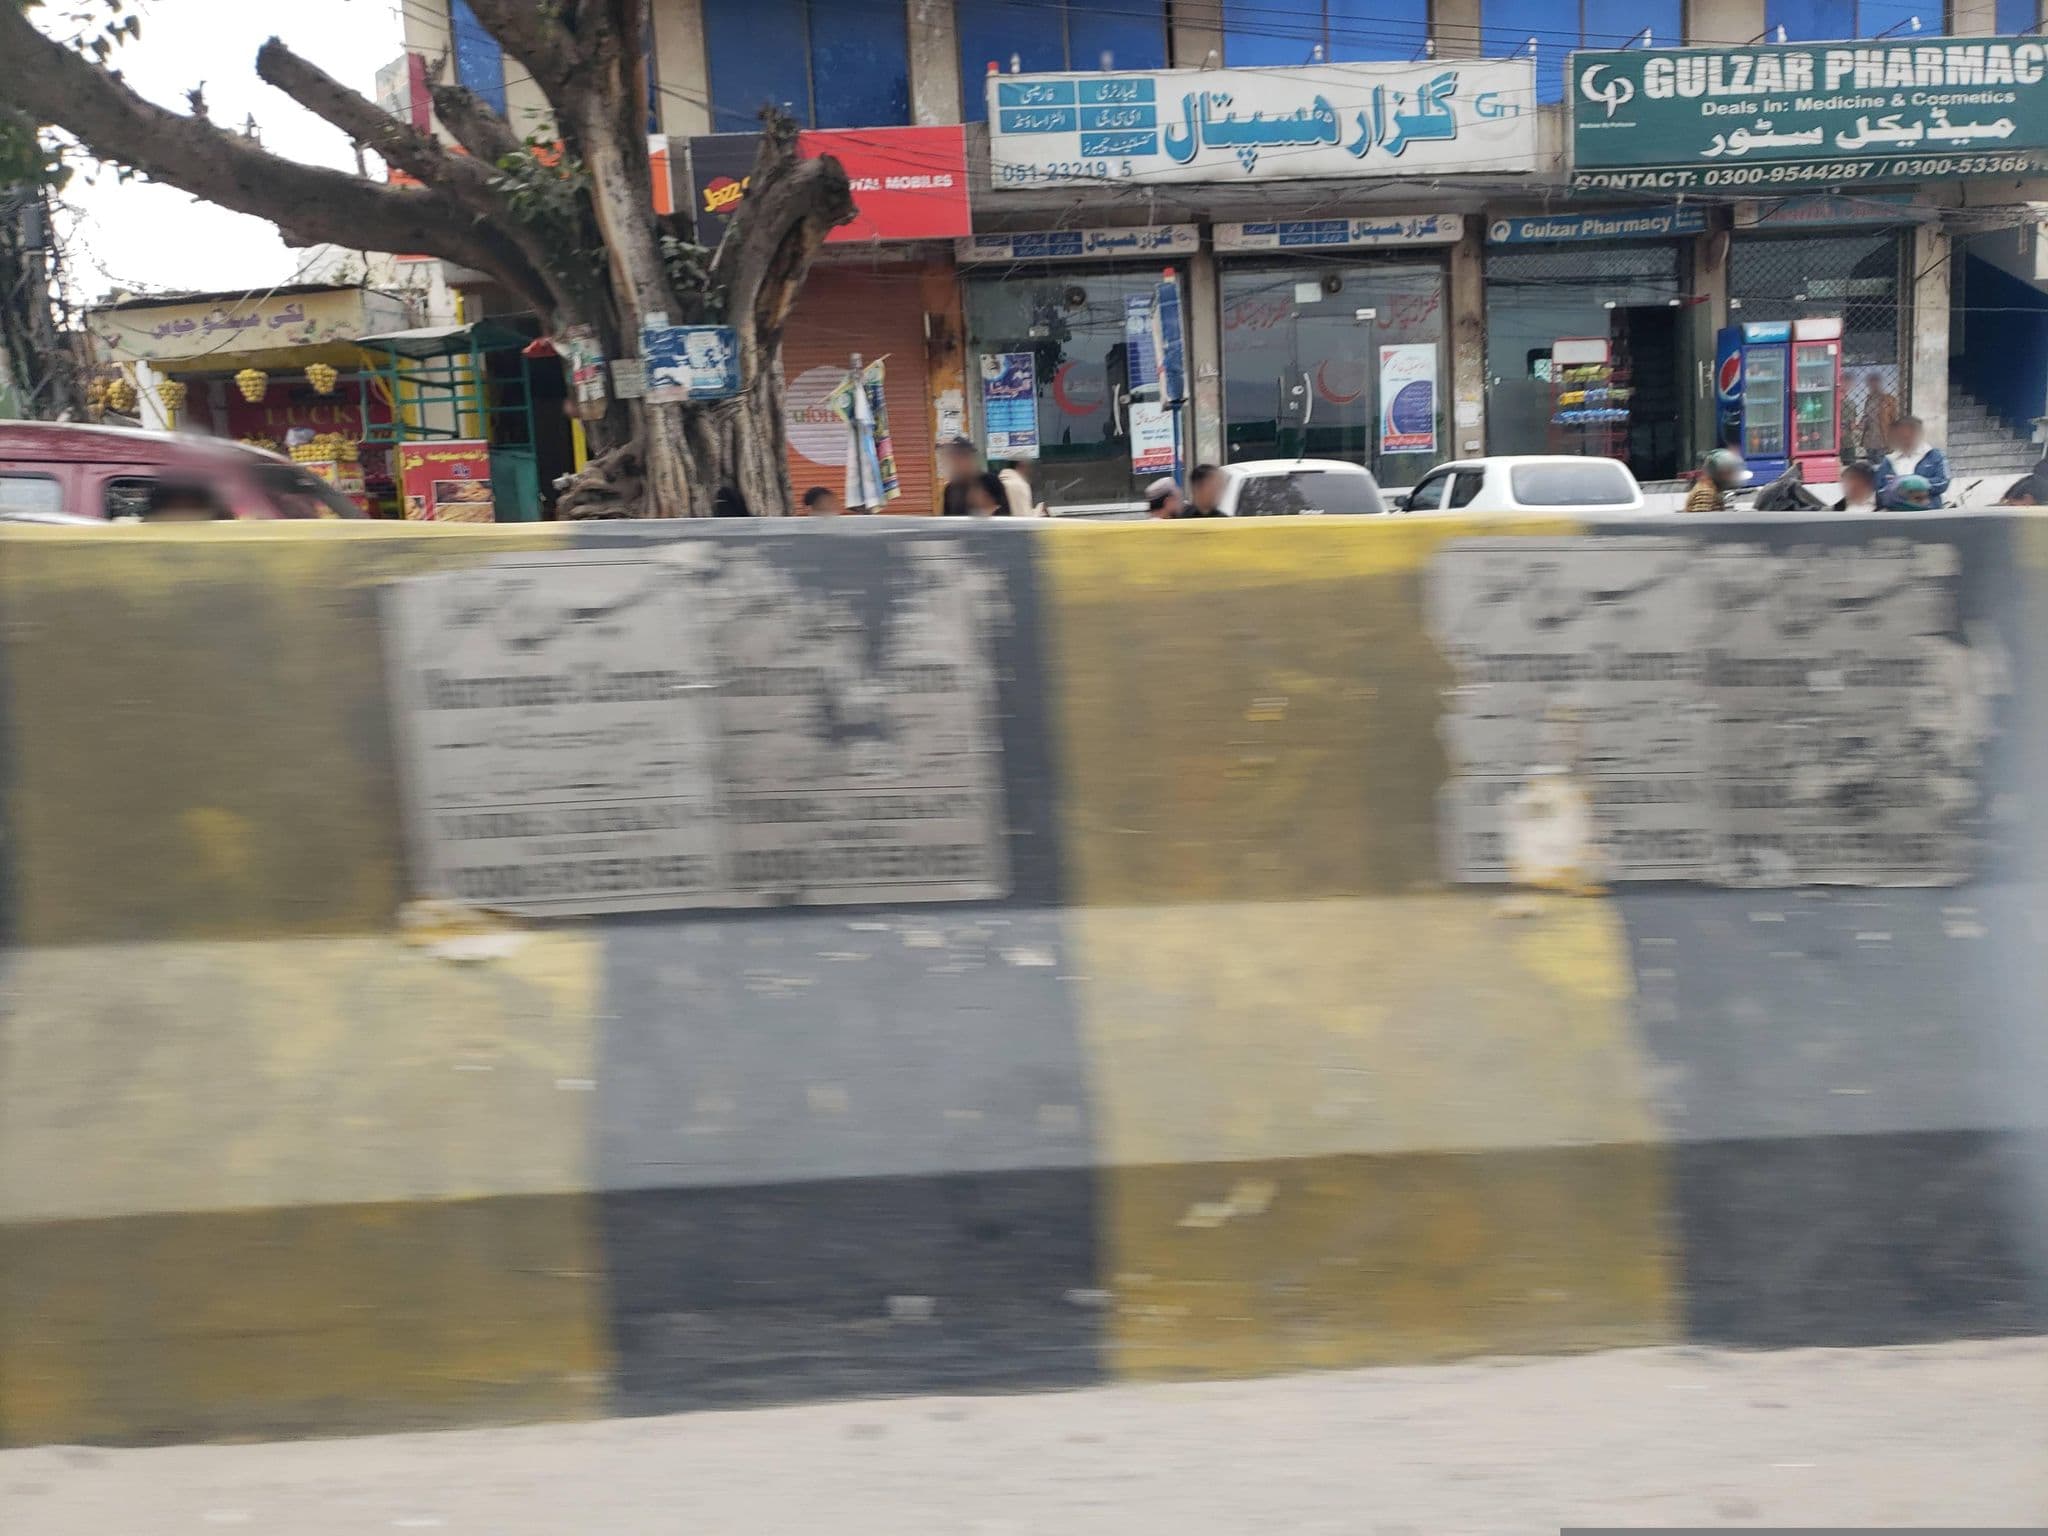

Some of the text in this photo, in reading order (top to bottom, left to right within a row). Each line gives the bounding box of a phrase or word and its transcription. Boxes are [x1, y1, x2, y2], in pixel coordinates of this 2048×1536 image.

[1644, 43, 2048, 99] GULZAR PHARMAC
[1346, 72, 1460, 158] گلزار
[1701, 90, 2016, 116] Deals In: Medicine & Cosmetics
[1700, 107, 2017, 157] میڈیکل سٹور
[885, 173, 953, 189] MOBILES
[1574, 171, 1697, 191] CONTACT:
[1704, 162, 1875, 186] 0300-9544287
[1877, 161, 1889, 177] /
[1520, 219, 1579, 238] Gulzar
[1581, 214, 1672, 236] Pharmacy
